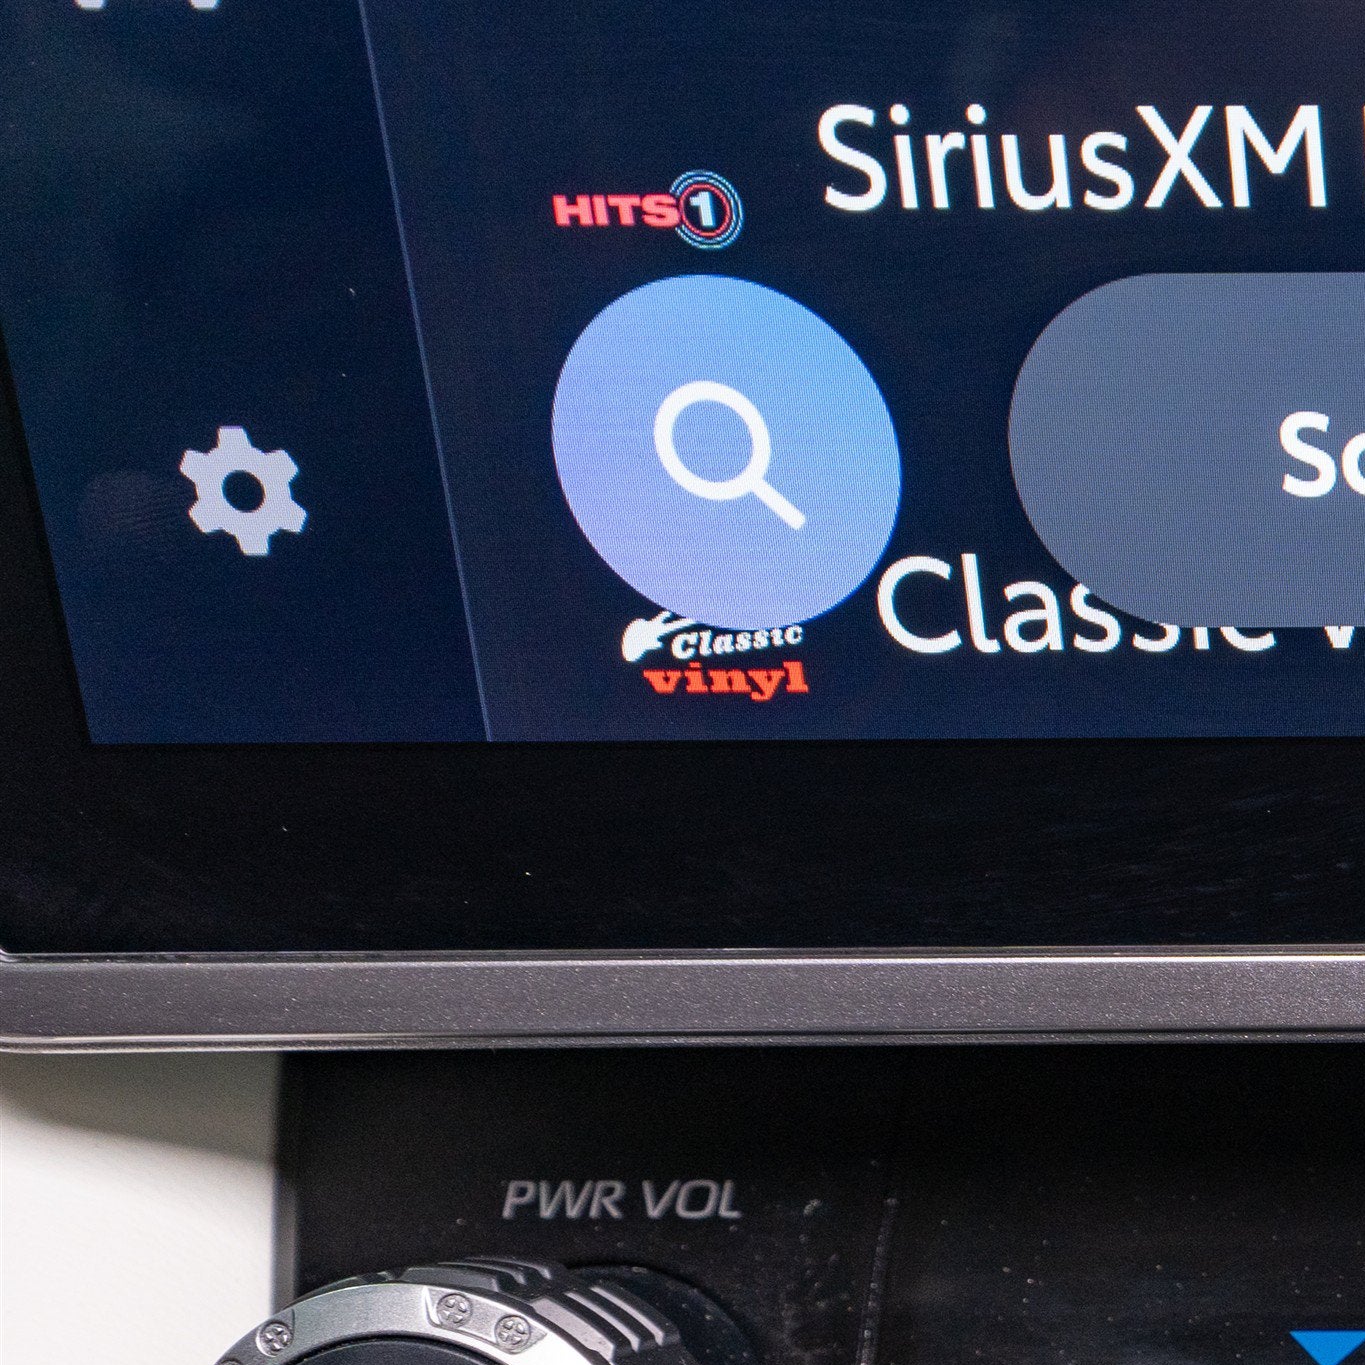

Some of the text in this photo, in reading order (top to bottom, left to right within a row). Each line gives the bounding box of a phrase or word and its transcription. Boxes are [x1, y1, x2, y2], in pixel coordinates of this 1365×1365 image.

[818, 103, 1328, 213] SiriusXM
[643, 660, 809, 702] vinyl
[502, 1179, 742, 1220] PWR VOL
